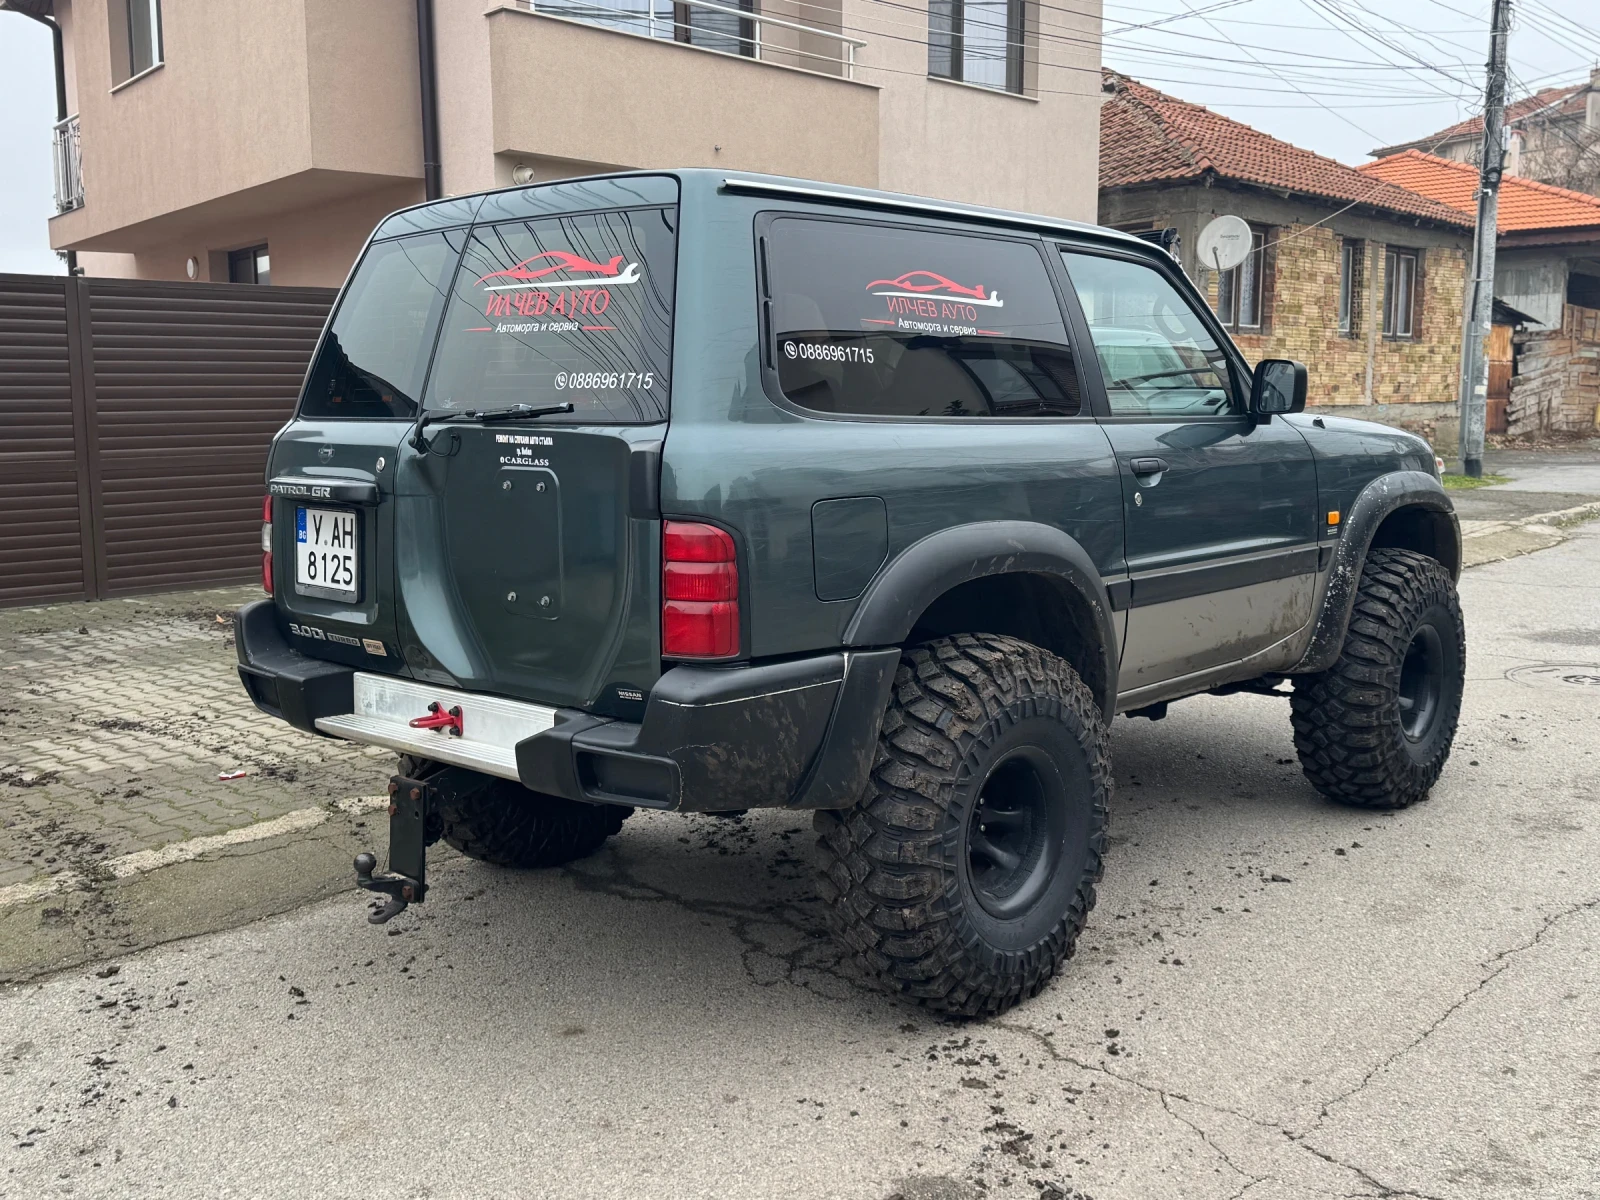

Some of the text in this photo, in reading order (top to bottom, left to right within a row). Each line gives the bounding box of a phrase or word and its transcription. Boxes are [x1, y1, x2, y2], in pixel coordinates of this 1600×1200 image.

[485, 289, 611, 319] ИЛЧЕВ АУТО
[886, 296, 977, 321] ИЛЧЕВ АУТО
[495, 322, 579, 334] Автоморга и сервиз
[898, 317, 977, 336] Автоморга и сервиз
[799, 342, 875, 364] 0886961715
[569, 371, 654, 390] 0886961715
[270, 484, 331, 498] PATROL GR
[298, 530, 307, 540] BG
[307, 551, 353, 586] 8125
[328, 634, 359, 646] TURBO
[618, 690, 642, 698] NISSAN
